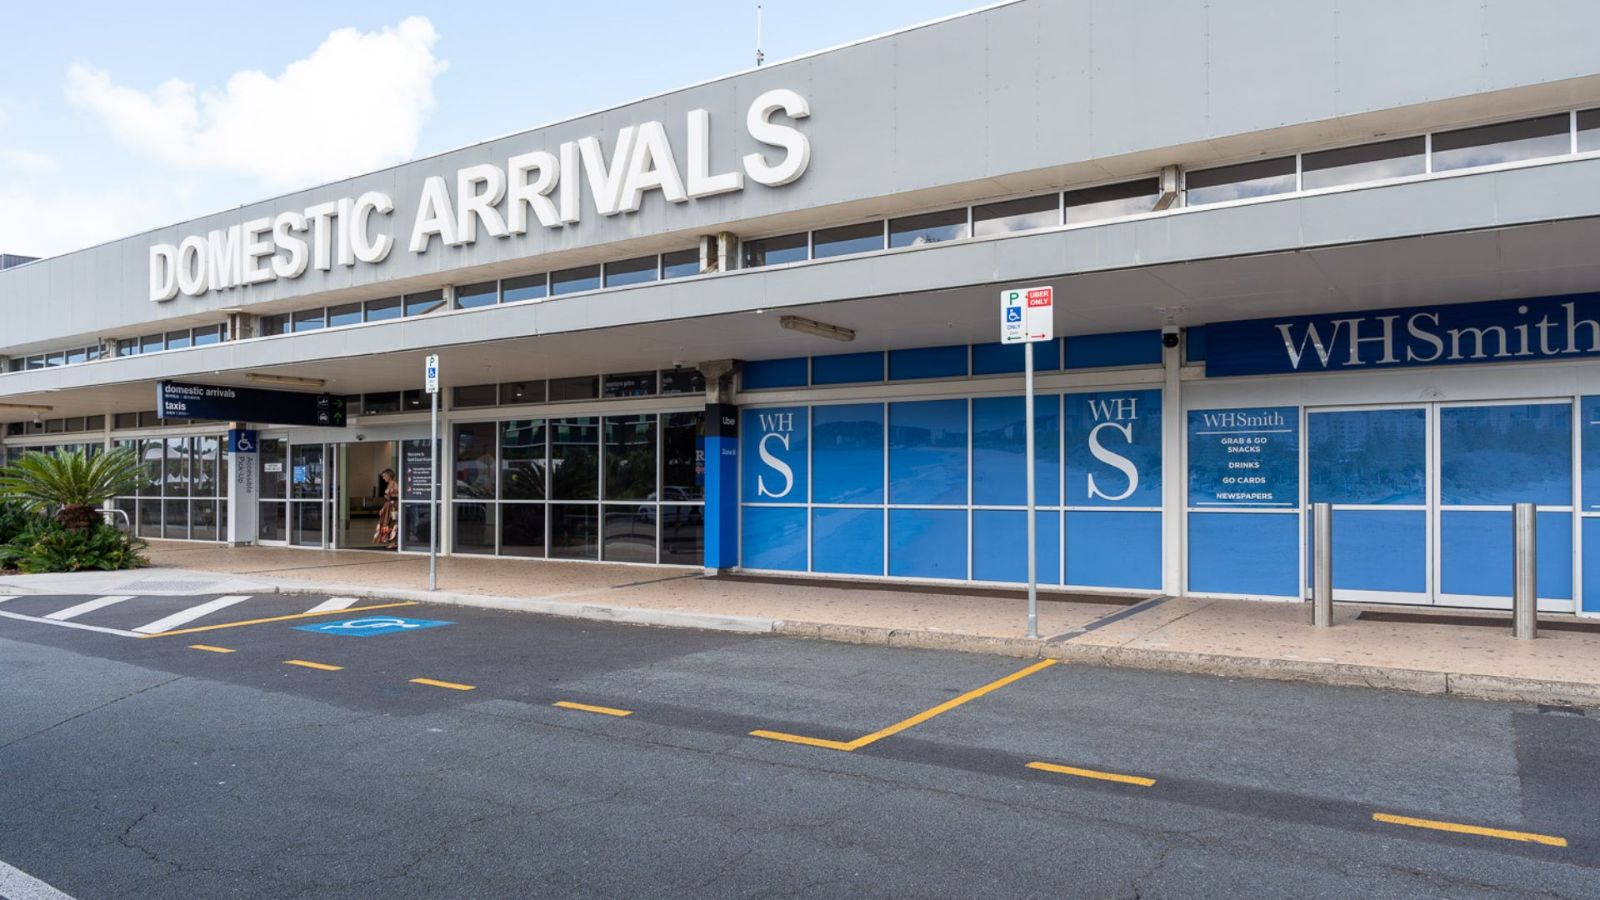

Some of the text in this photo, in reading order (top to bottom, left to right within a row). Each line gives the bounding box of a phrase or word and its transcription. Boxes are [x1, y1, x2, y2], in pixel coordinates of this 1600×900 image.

[149, 88, 811, 302] DOMESTIC ARRIVALS
[1009, 292, 1020, 305] P
[1029, 290, 1049, 299] UBER
[1030, 298, 1048, 306] ONLY
[1275, 302, 1600, 370] WHSmith
[429, 357, 435, 366] P
[164, 384, 204, 396] domestic
[205, 388, 236, 398] arrivals
[165, 401, 187, 411] taxis
[1088, 398, 1139, 421] WH
[722, 416, 736, 426] Uber
[759, 413, 795, 432] WH
[1203, 411, 1285, 428] WHSmith
[758, 433, 794, 497] S
[1087, 422, 1139, 500] S
